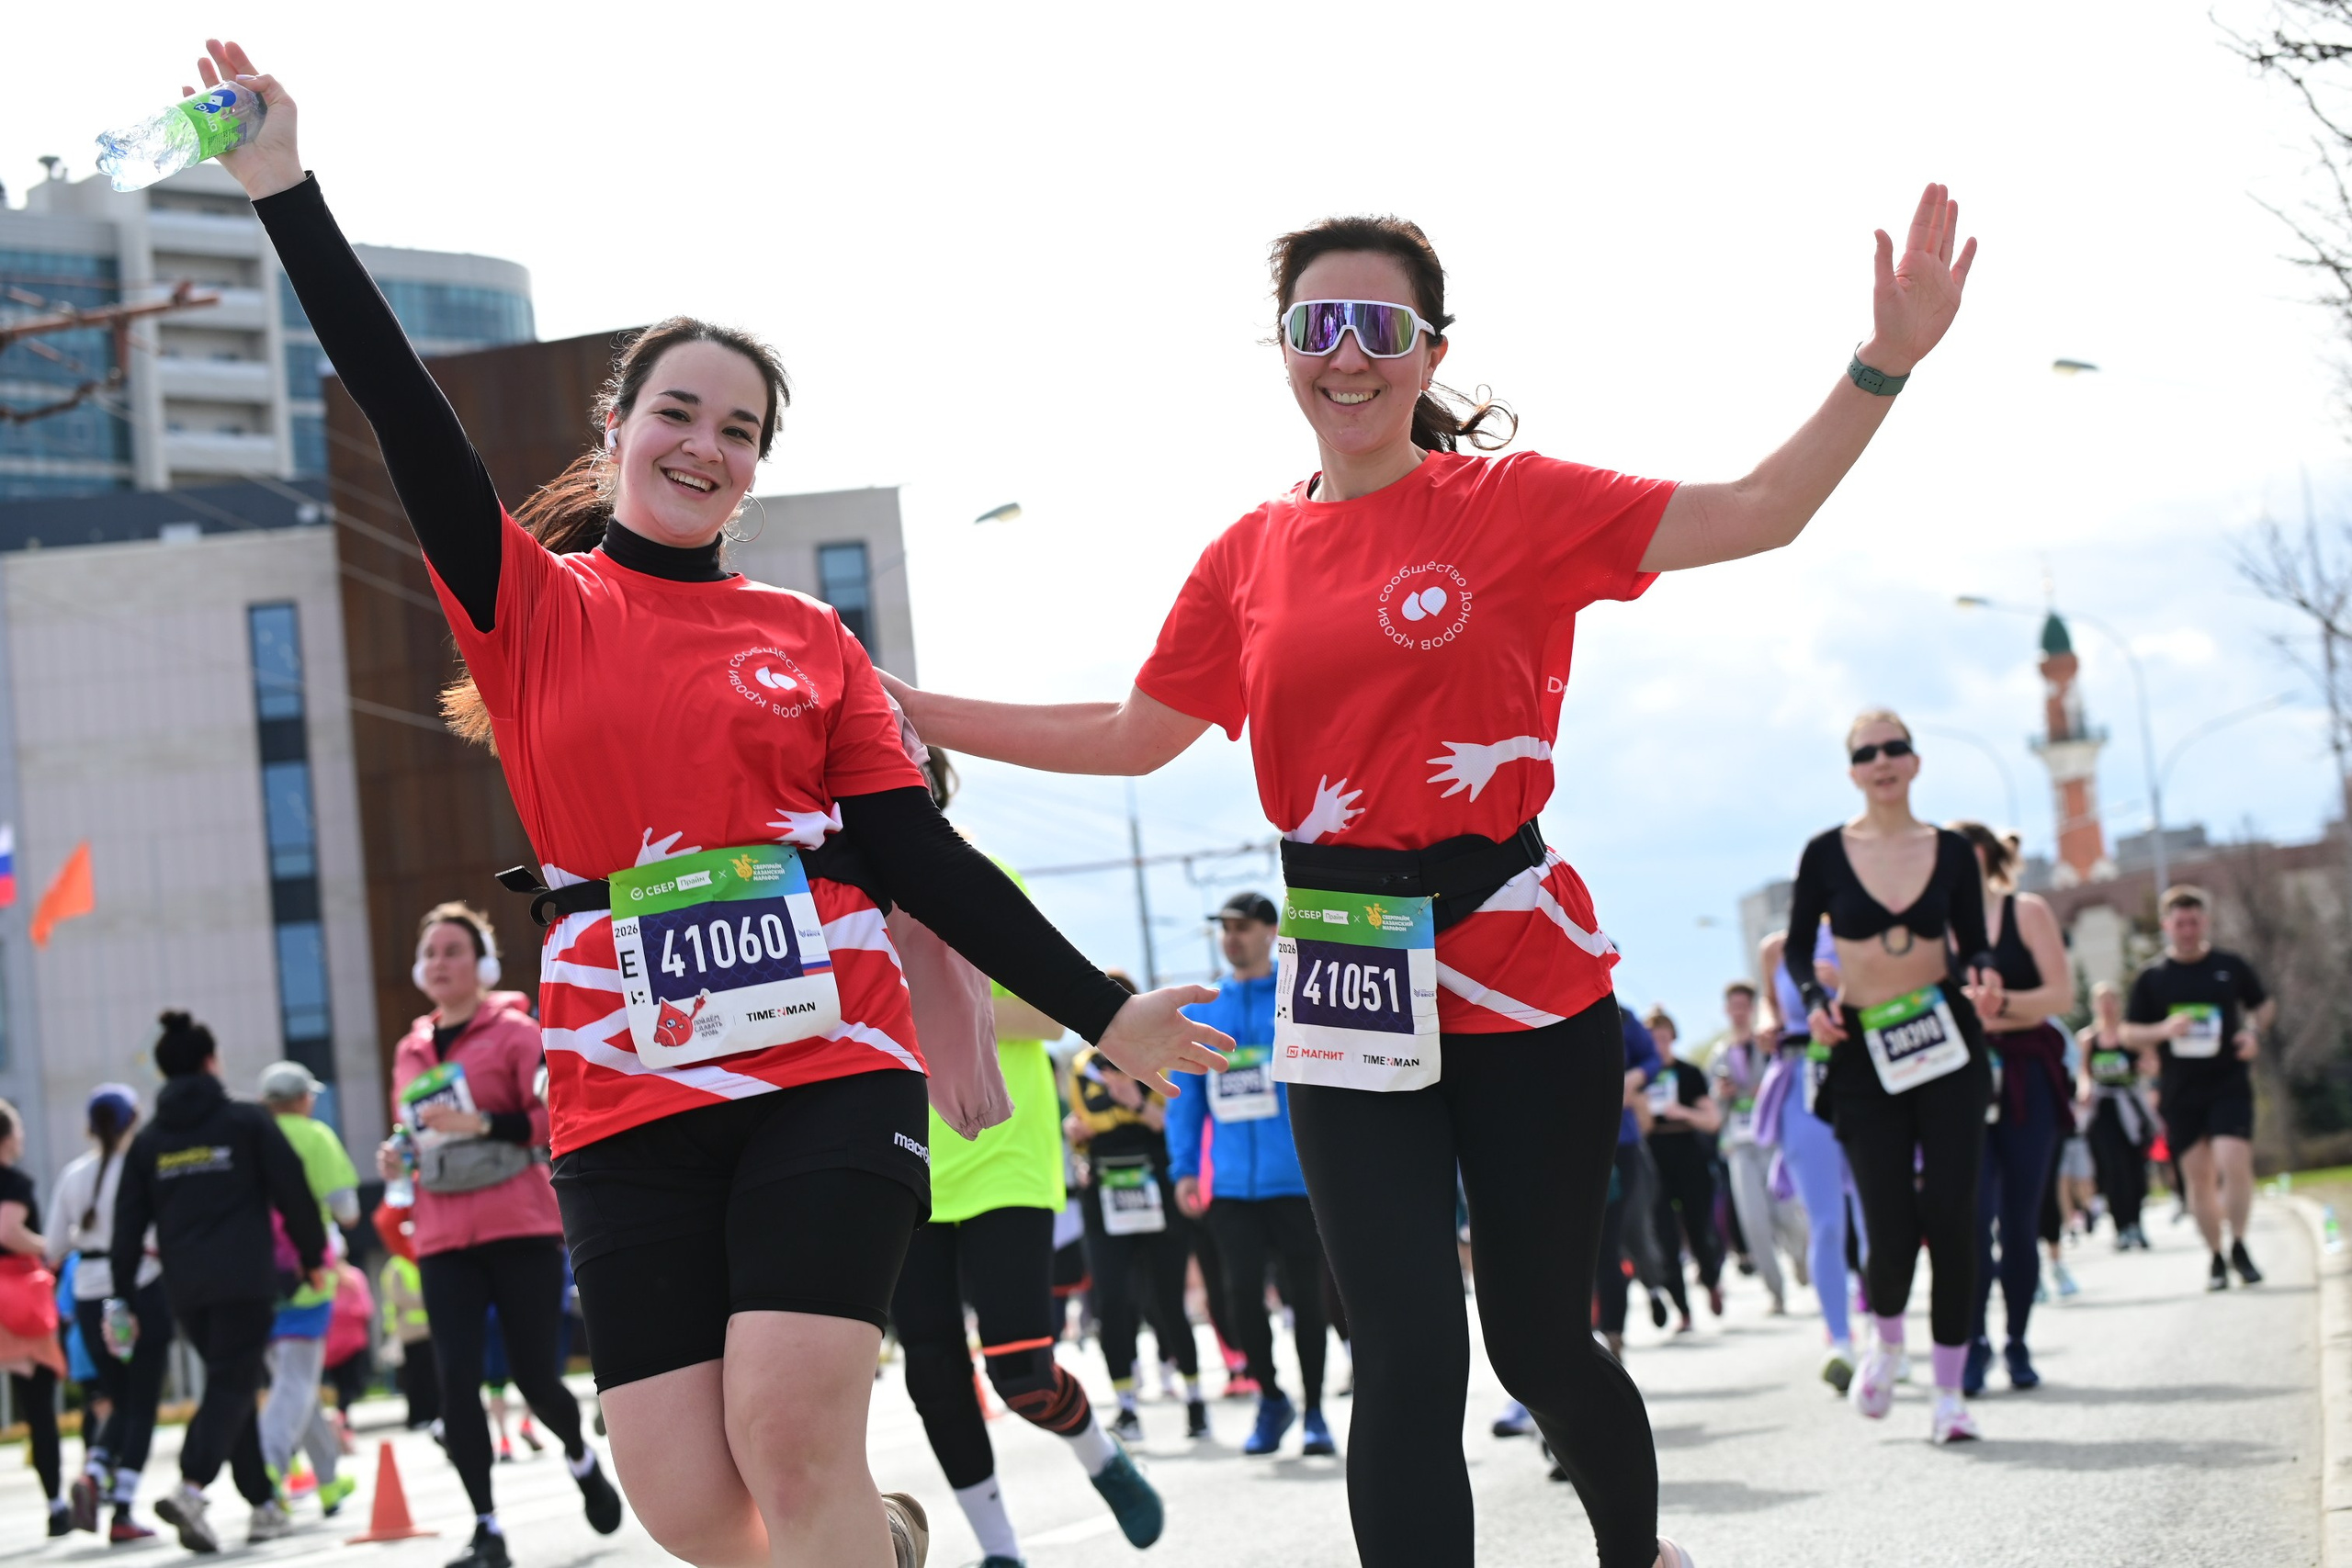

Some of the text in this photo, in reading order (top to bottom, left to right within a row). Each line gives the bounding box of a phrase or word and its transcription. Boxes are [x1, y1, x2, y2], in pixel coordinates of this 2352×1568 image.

[1547, 675, 1567, 694] D
[646, 882, 675, 897] СБЕР
[1298, 908, 1322, 920] СБЕР
[615, 924, 639, 938] 2026
[661, 913, 788, 978] 41060
[1278, 942, 1296, 954] 2026
[620, 949, 639, 979] E
[1302, 959, 1400, 1013] 41051
[1301, 1048, 1344, 1061] МАГНИТ
